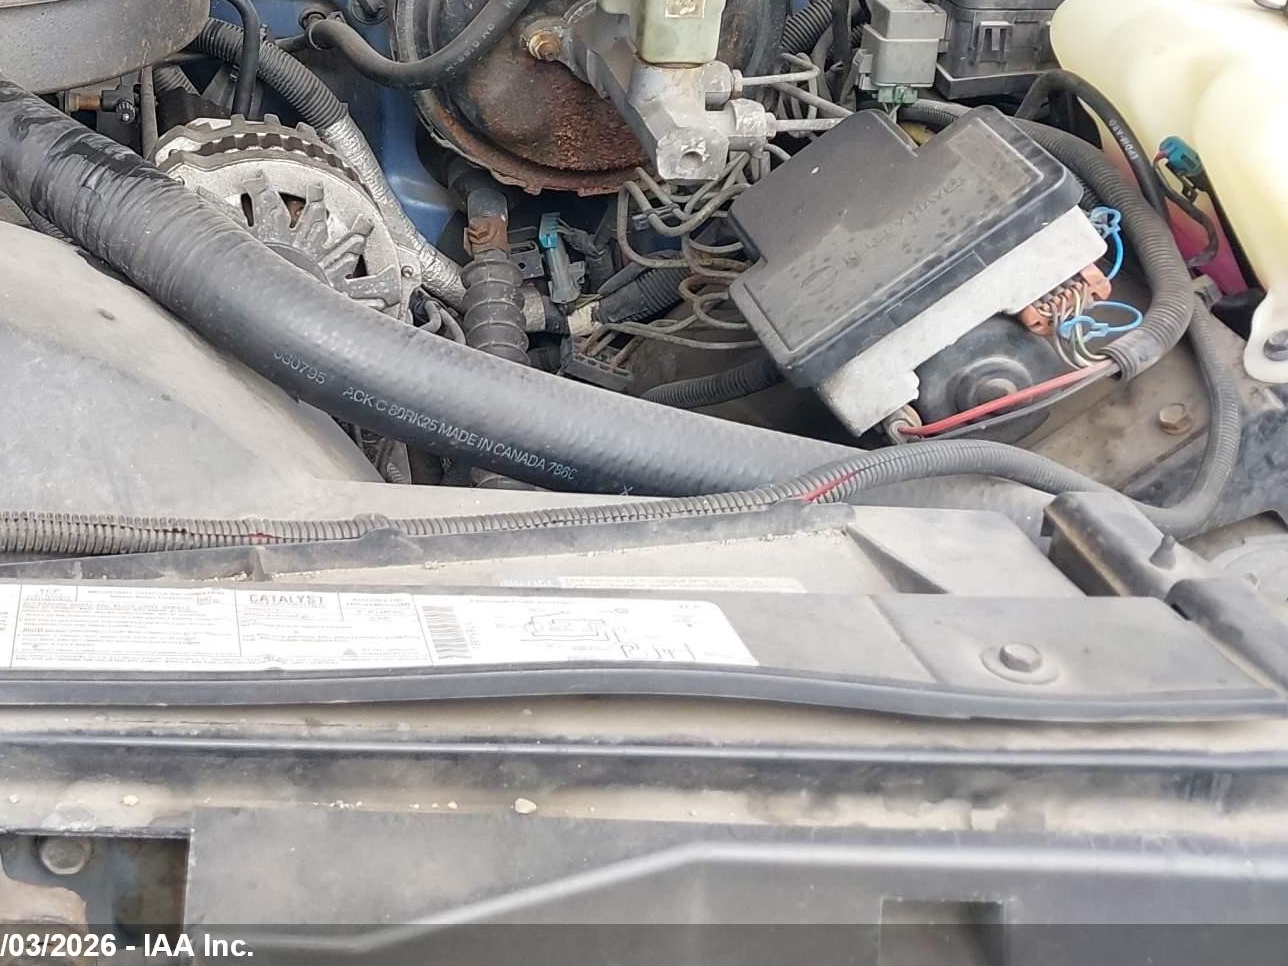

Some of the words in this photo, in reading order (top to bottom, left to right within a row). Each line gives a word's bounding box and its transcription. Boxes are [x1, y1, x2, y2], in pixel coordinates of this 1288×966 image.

[437, 422, 478, 446] MADE
[477, 436, 494, 452] IN
[492, 442, 546, 470] CANADA
[249, 594, 323, 605] CATALYST
